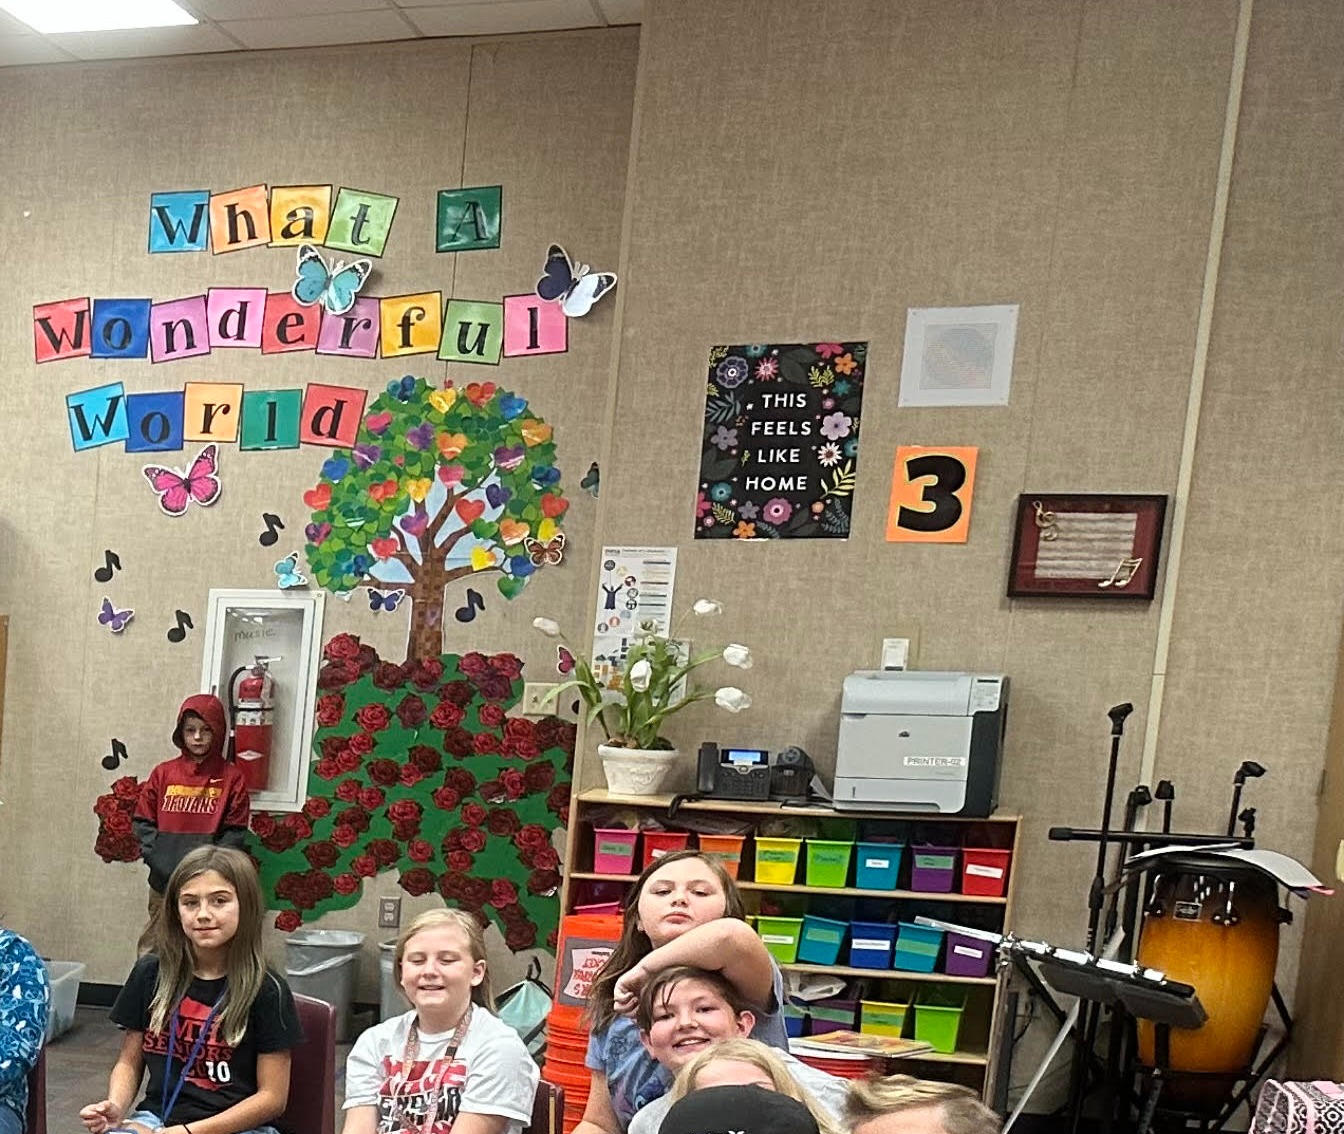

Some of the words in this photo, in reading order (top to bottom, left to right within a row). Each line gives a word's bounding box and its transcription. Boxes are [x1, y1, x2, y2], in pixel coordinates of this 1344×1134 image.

[151, 200, 371, 247] What
[450, 199, 489, 242] A
[34, 300, 543, 357] Wonderful
[69, 388, 346, 445] World
[762, 393, 807, 409] THIS
[751, 421, 812, 436] FEELS
[758, 448, 801, 463] LIKE
[745, 476, 808, 492] HOME
[896, 454, 968, 533] 3
